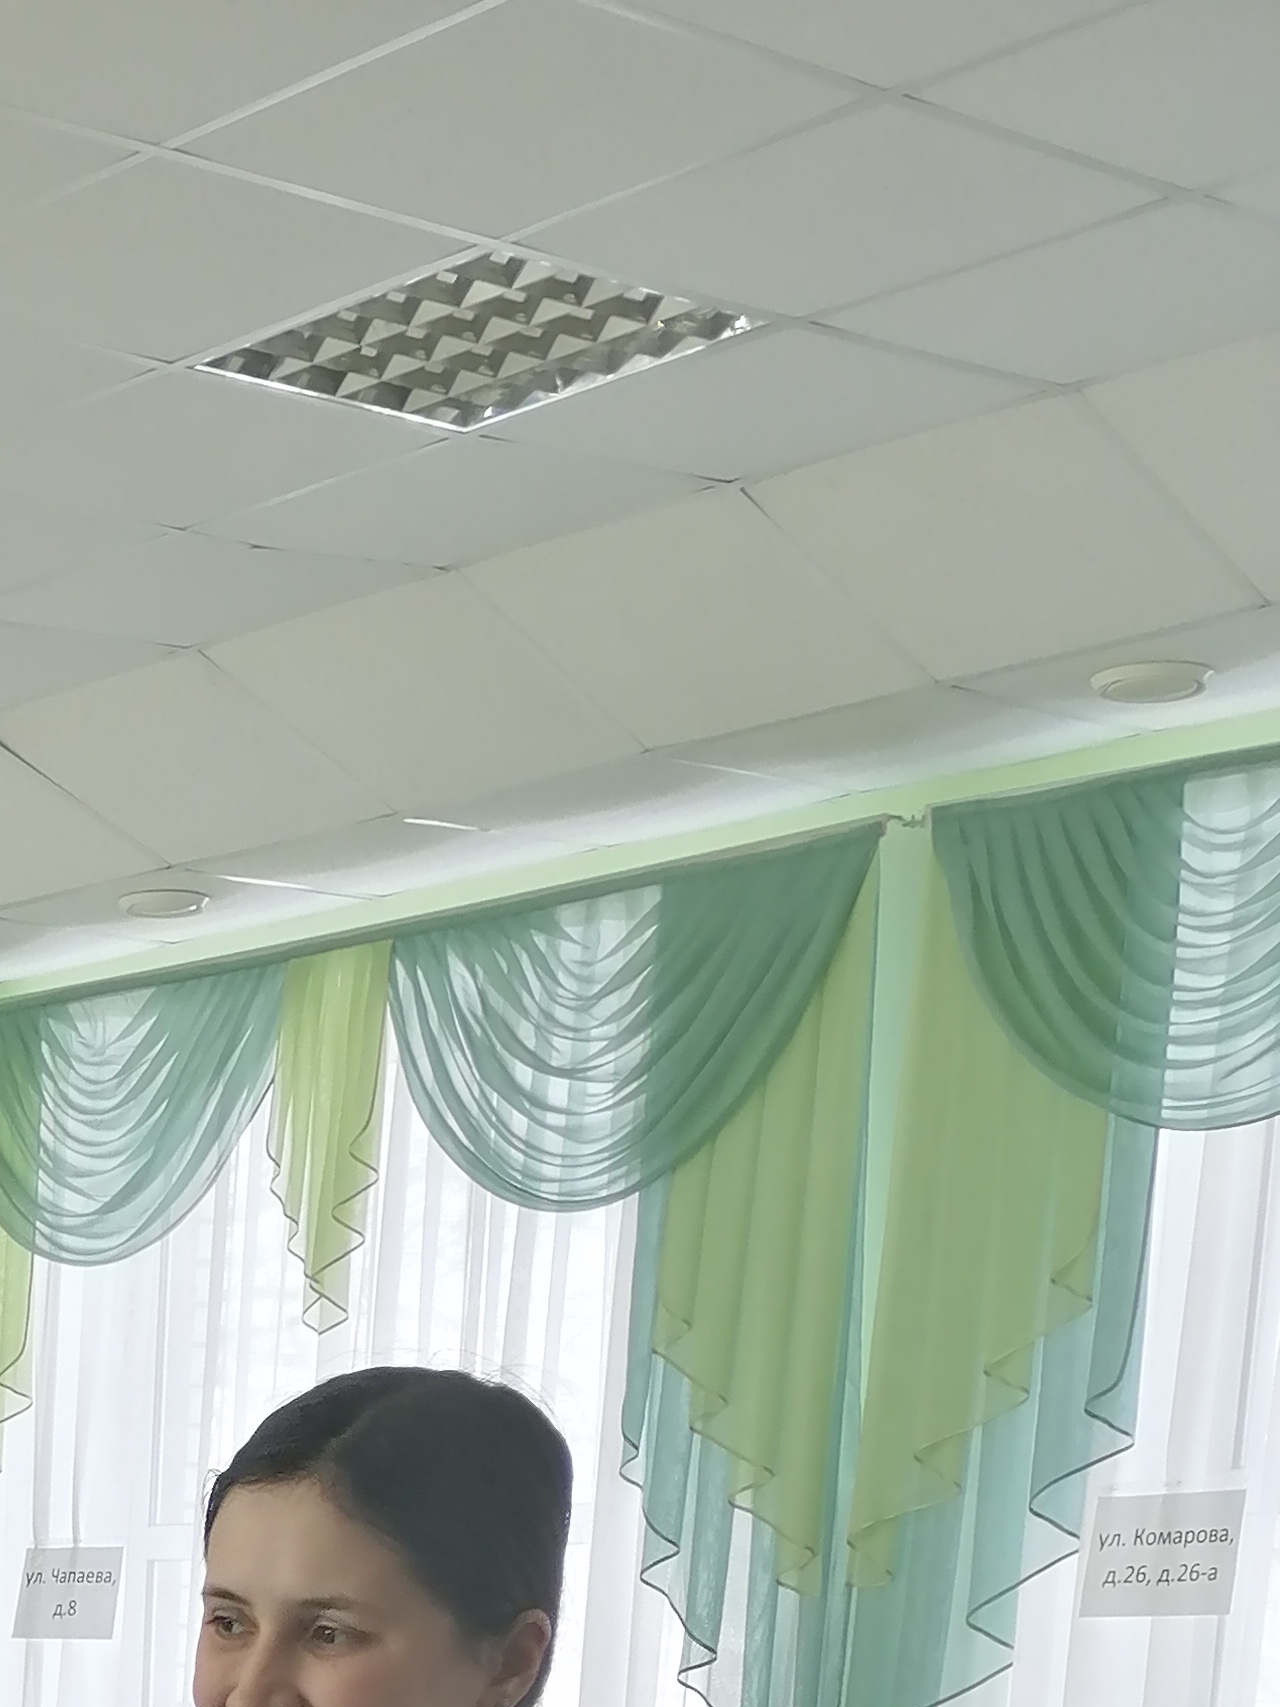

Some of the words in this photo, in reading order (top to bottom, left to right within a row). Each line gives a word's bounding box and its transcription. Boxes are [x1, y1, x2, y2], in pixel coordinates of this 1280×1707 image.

[1098, 1532, 1126, 1551] ул.
[1133, 1527, 1235, 1548] Комарова,
[24, 1570, 46, 1588] ул.
[50, 1568, 117, 1587] Чапаева,
[1101, 1564, 1152, 1588] д.26,
[1156, 1562, 1219, 1587] д.26-а
[51, 1599, 78, 1620] д.8
